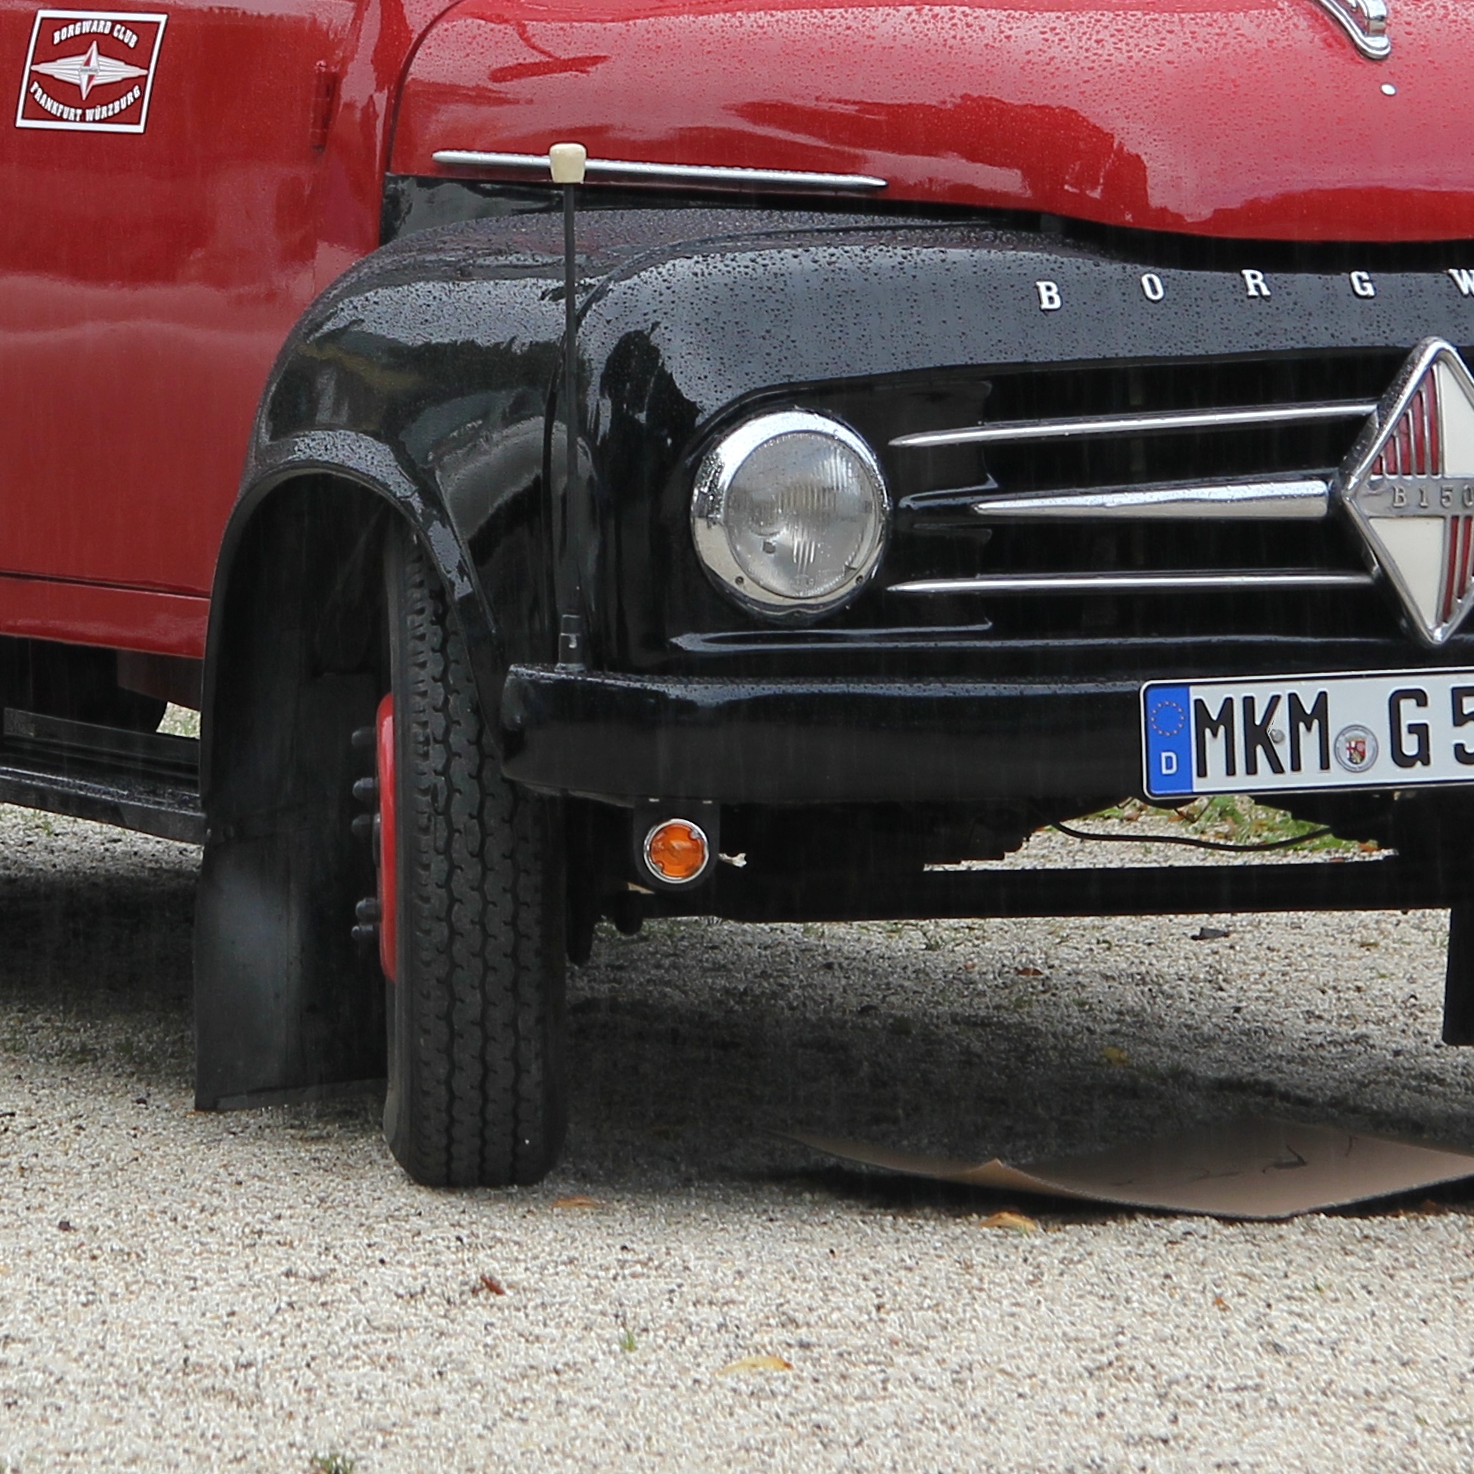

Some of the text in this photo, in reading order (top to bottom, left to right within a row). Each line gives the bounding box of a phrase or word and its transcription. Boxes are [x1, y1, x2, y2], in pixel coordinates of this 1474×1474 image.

[52, 19, 139, 49] BORGWARD CLUB
[29, 80, 142, 122] FRANKFURT WÜRZBURG
[1161, 751, 1178, 776] D
[1192, 689, 1331, 778] MKM
[1388, 687, 1431, 769] G
